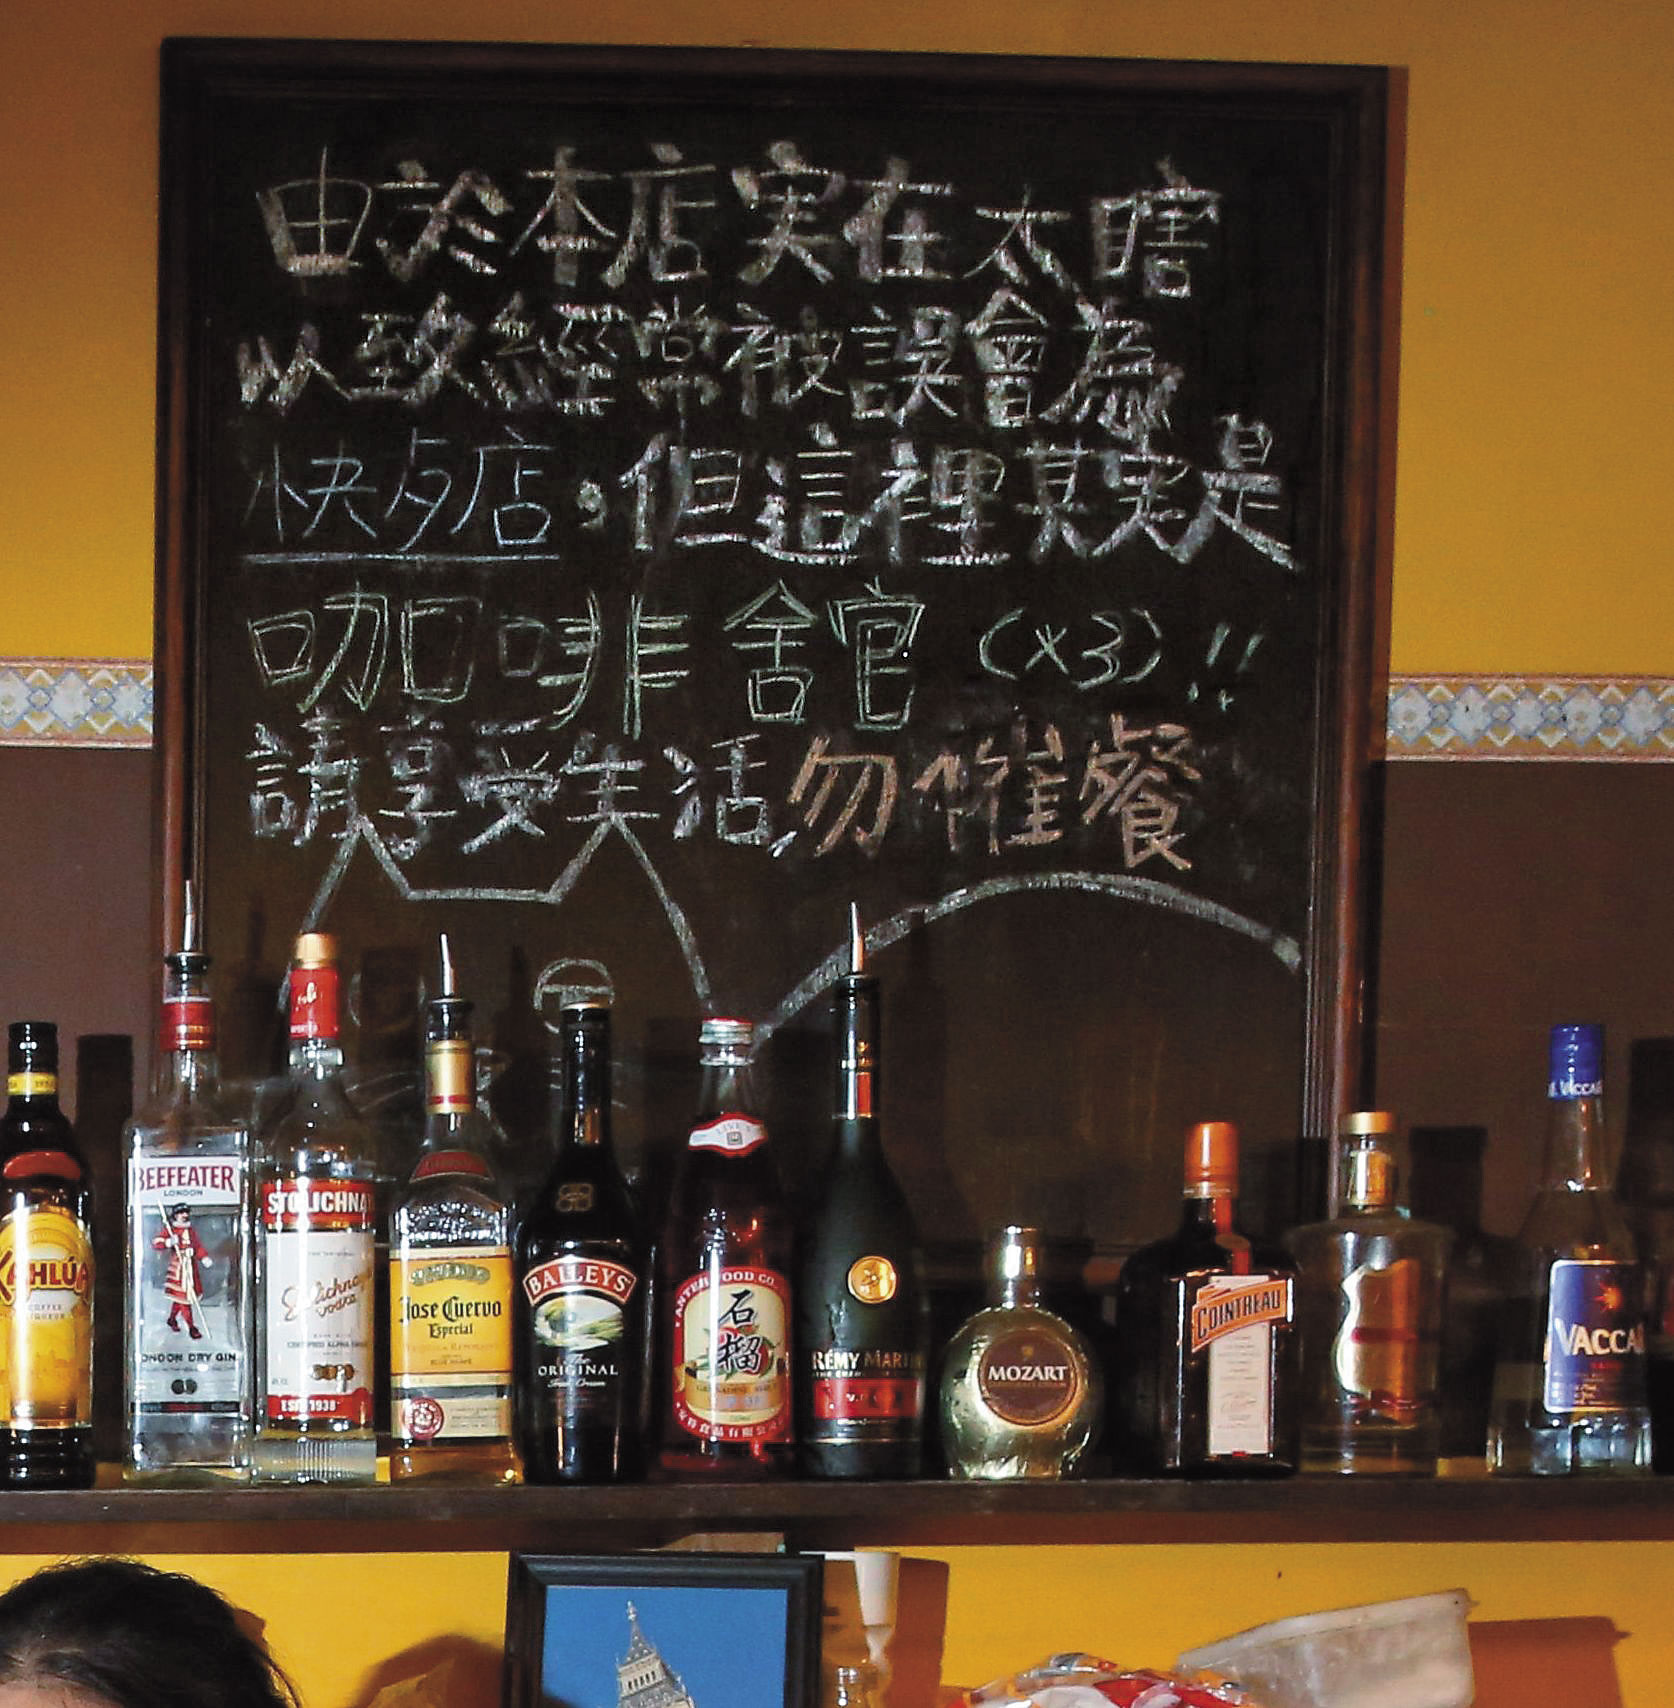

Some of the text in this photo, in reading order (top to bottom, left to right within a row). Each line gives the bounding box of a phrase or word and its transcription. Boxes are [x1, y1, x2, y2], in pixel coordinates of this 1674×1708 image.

[528, 1265, 628, 1296] BAILEYS
[721, 1271, 755, 1282] OOD
[442, 1295, 502, 1323] Cuervo
[1197, 1289, 1281, 1339] COINTREAU
[428, 1322, 473, 1339] Especial
[141, 1352, 236, 1363] ONDON DRY GIN
[537, 1364, 619, 1377] ORIGINAL
[987, 1365, 1068, 1381] MOZART
